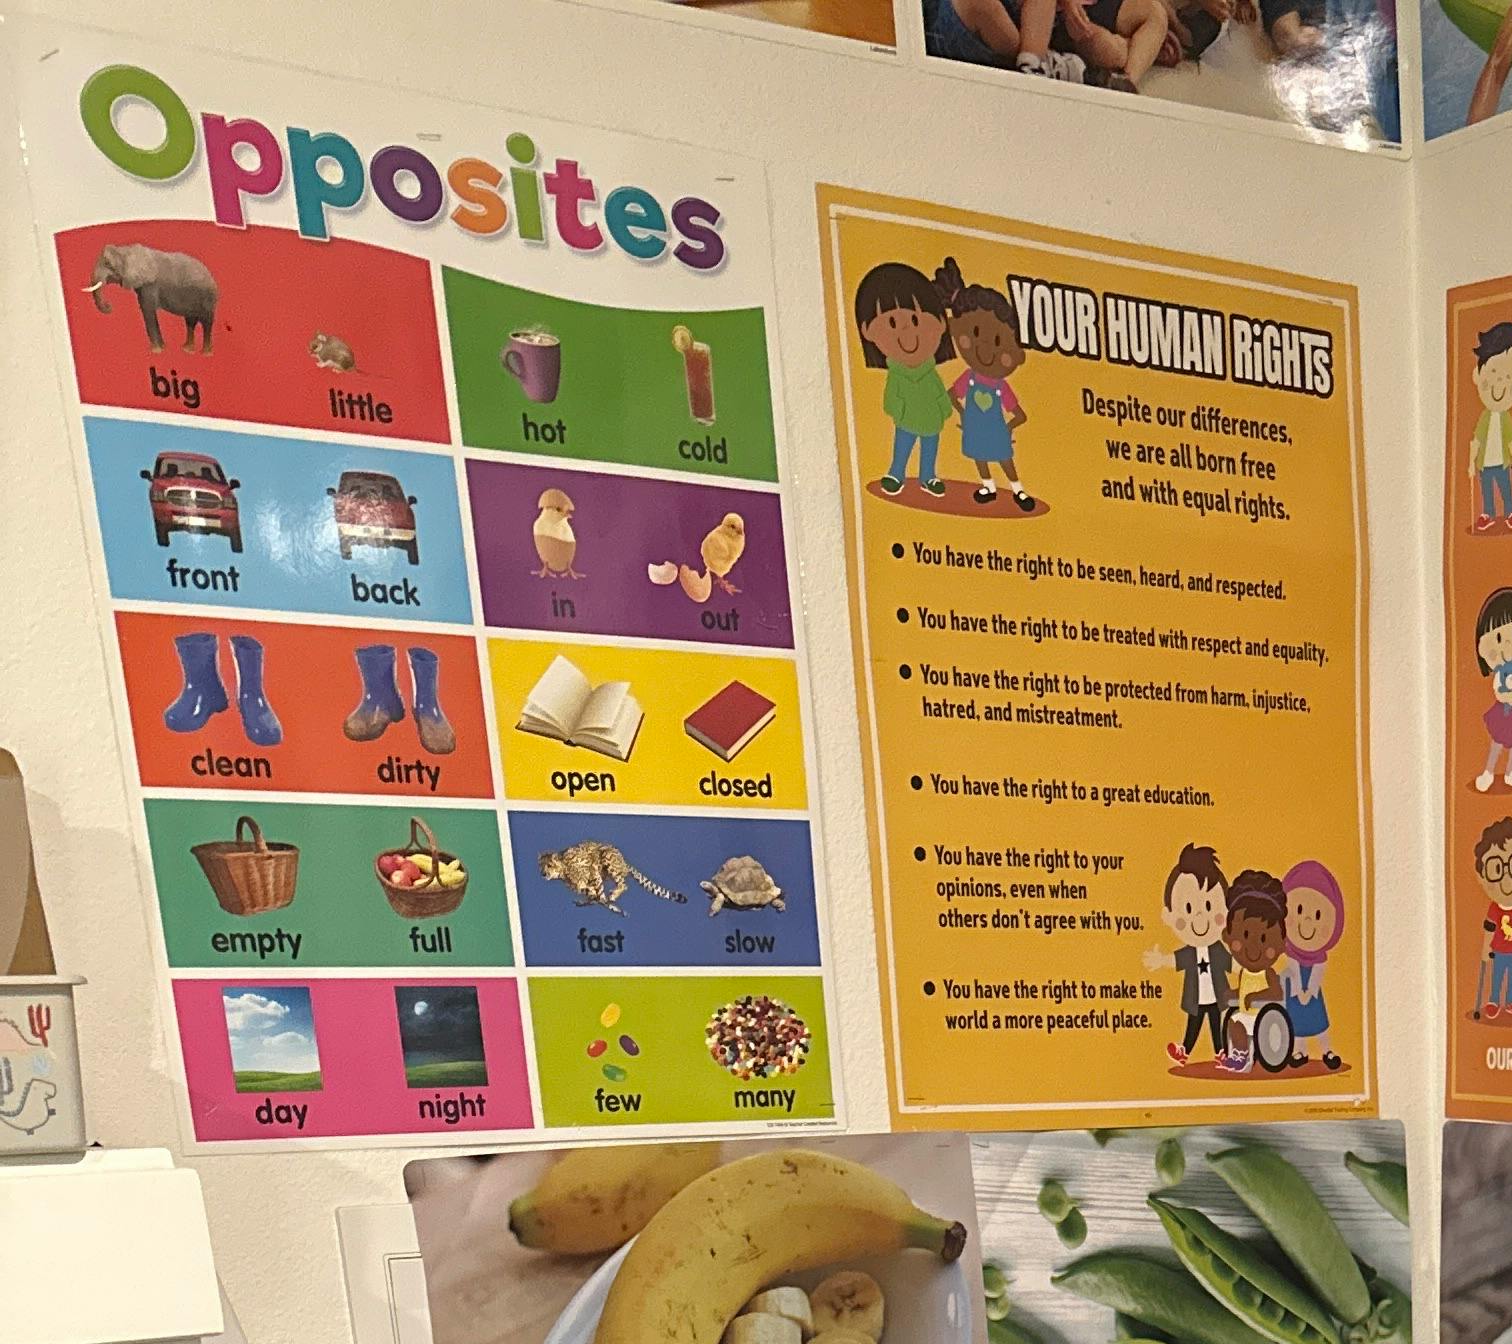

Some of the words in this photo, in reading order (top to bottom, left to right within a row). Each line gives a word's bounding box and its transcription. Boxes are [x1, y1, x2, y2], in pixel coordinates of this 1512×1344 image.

[80, 64, 728, 272] Opposites
[1008, 276, 1098, 357] YOUR
[1105, 296, 1224, 377] HUMAN
[149, 367, 201, 409] big
[329, 388, 393, 424] little
[1082, 388, 1152, 427] Despite
[1156, 407, 1186, 428] our
[1191, 405, 1292, 446] differences,
[522, 412, 566, 444] hot
[678, 435, 728, 464] cold
[1106, 439, 1131, 461] we
[1136, 444, 1165, 465] are
[1170, 443, 1192, 469] all
[1195, 445, 1236, 475] born
[1240, 451, 1276, 480] free
[1101, 476, 1135, 501] and
[1139, 479, 1178, 506] with
[1183, 488, 1231, 517] equal
[1234, 490, 1290, 523] rights.
[166, 558, 240, 592] front
[351, 573, 420, 606] back
[551, 591, 576, 619] in
[701, 608, 740, 632] out
[917, 607, 946, 630] You
[950, 609, 988, 633] have
[991, 614, 1017, 635] the
[1021, 616, 1058, 643] right
[1061, 620, 1078, 640] to
[1081, 620, 1100, 642] be
[1103, 624, 1155, 647] treated
[1158, 629, 1188, 650] with
[1192, 636, 1242, 658] respect
[1245, 638, 1269, 657] and
[1272, 642, 1329, 668] equality.
[191, 748, 272, 778] clean
[377, 756, 440, 792] dirty
[551, 771, 615, 797] open
[699, 770, 772, 798] closed
[211, 928, 302, 960] empty
[409, 926, 452, 953] full
[577, 927, 625, 953] fast
[725, 929, 775, 953] slow
[255, 1098, 308, 1130] day
[419, 1092, 486, 1124] night
[594, 1088, 641, 1112] few
[734, 1089, 795, 1112] many
